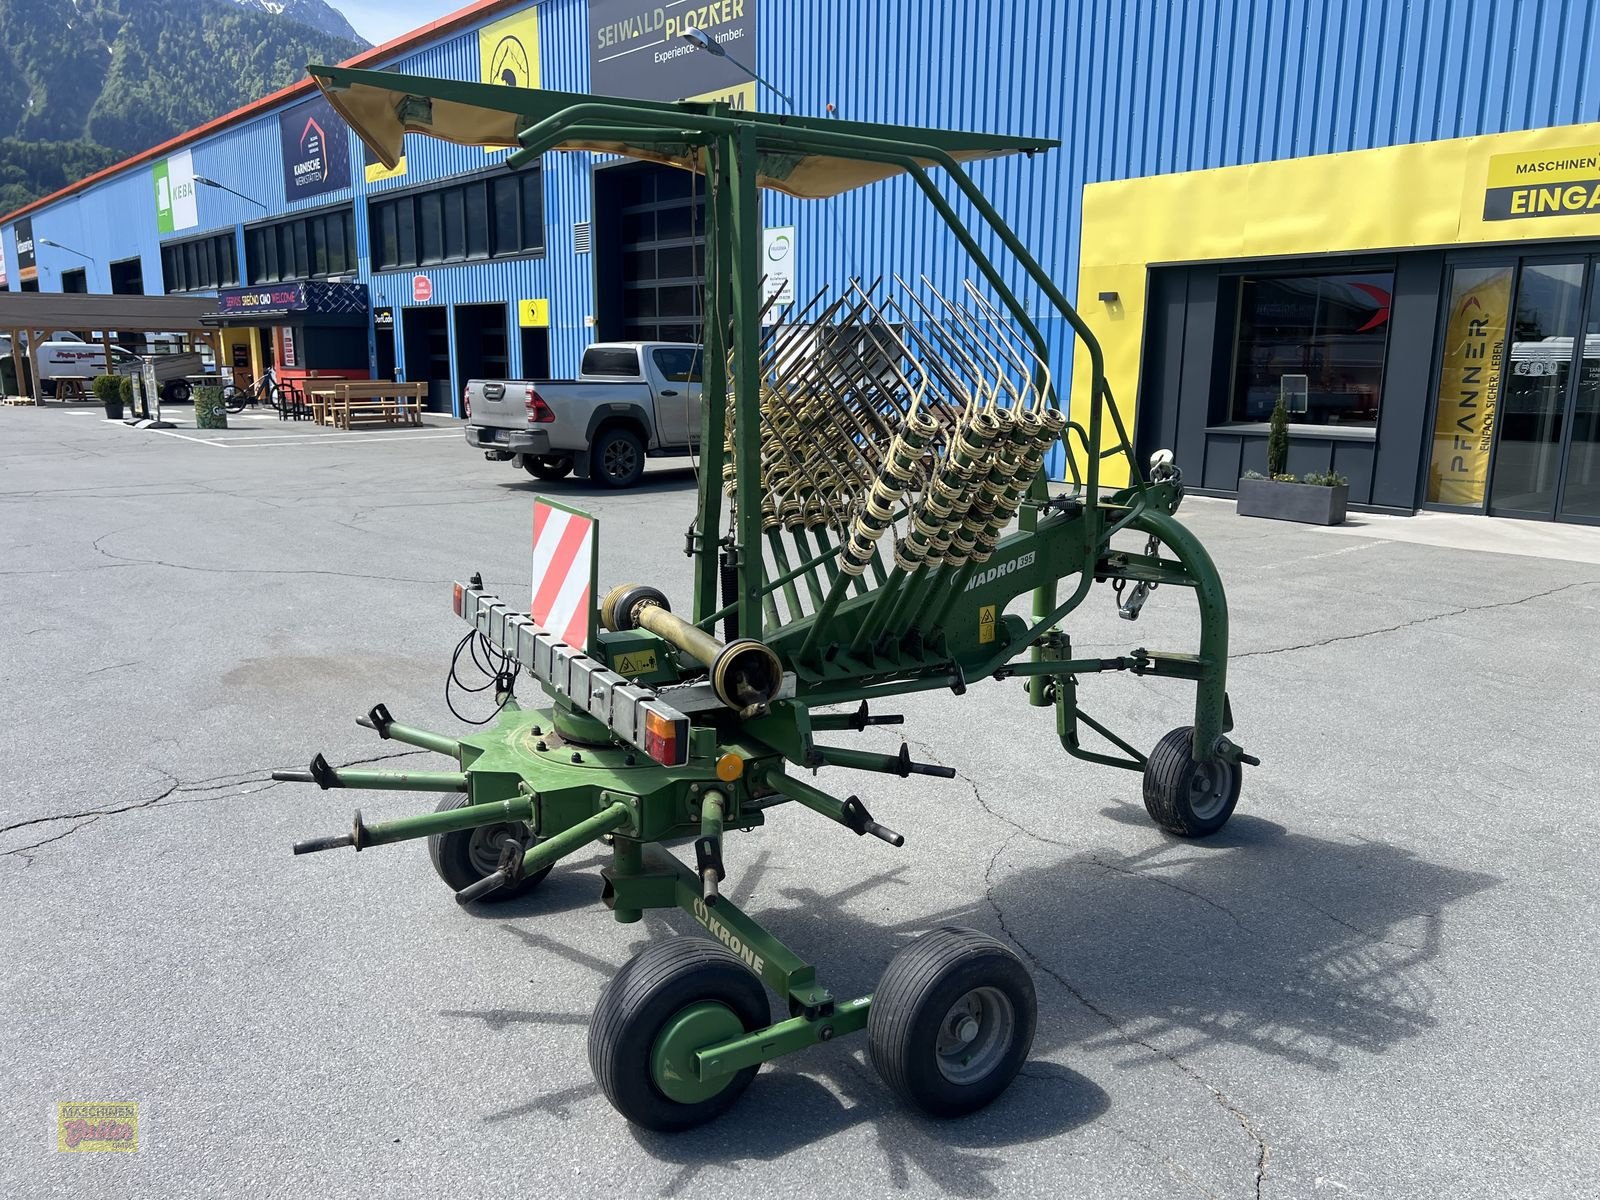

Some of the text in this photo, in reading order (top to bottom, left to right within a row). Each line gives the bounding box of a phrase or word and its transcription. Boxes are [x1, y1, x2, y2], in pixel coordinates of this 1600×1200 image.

[598, 8, 665, 49] SEIWALD
[654, 44, 695, 64] Experience
[294, 158, 321, 176] KARNISCHE
[1516, 157, 1597, 174] MASCHINEN
[173, 182, 193, 200] KEBA
[1451, 318, 1489, 473] PFANNER
[1019, 553, 1033, 567] 395
[709, 916, 764, 976] KRONE
